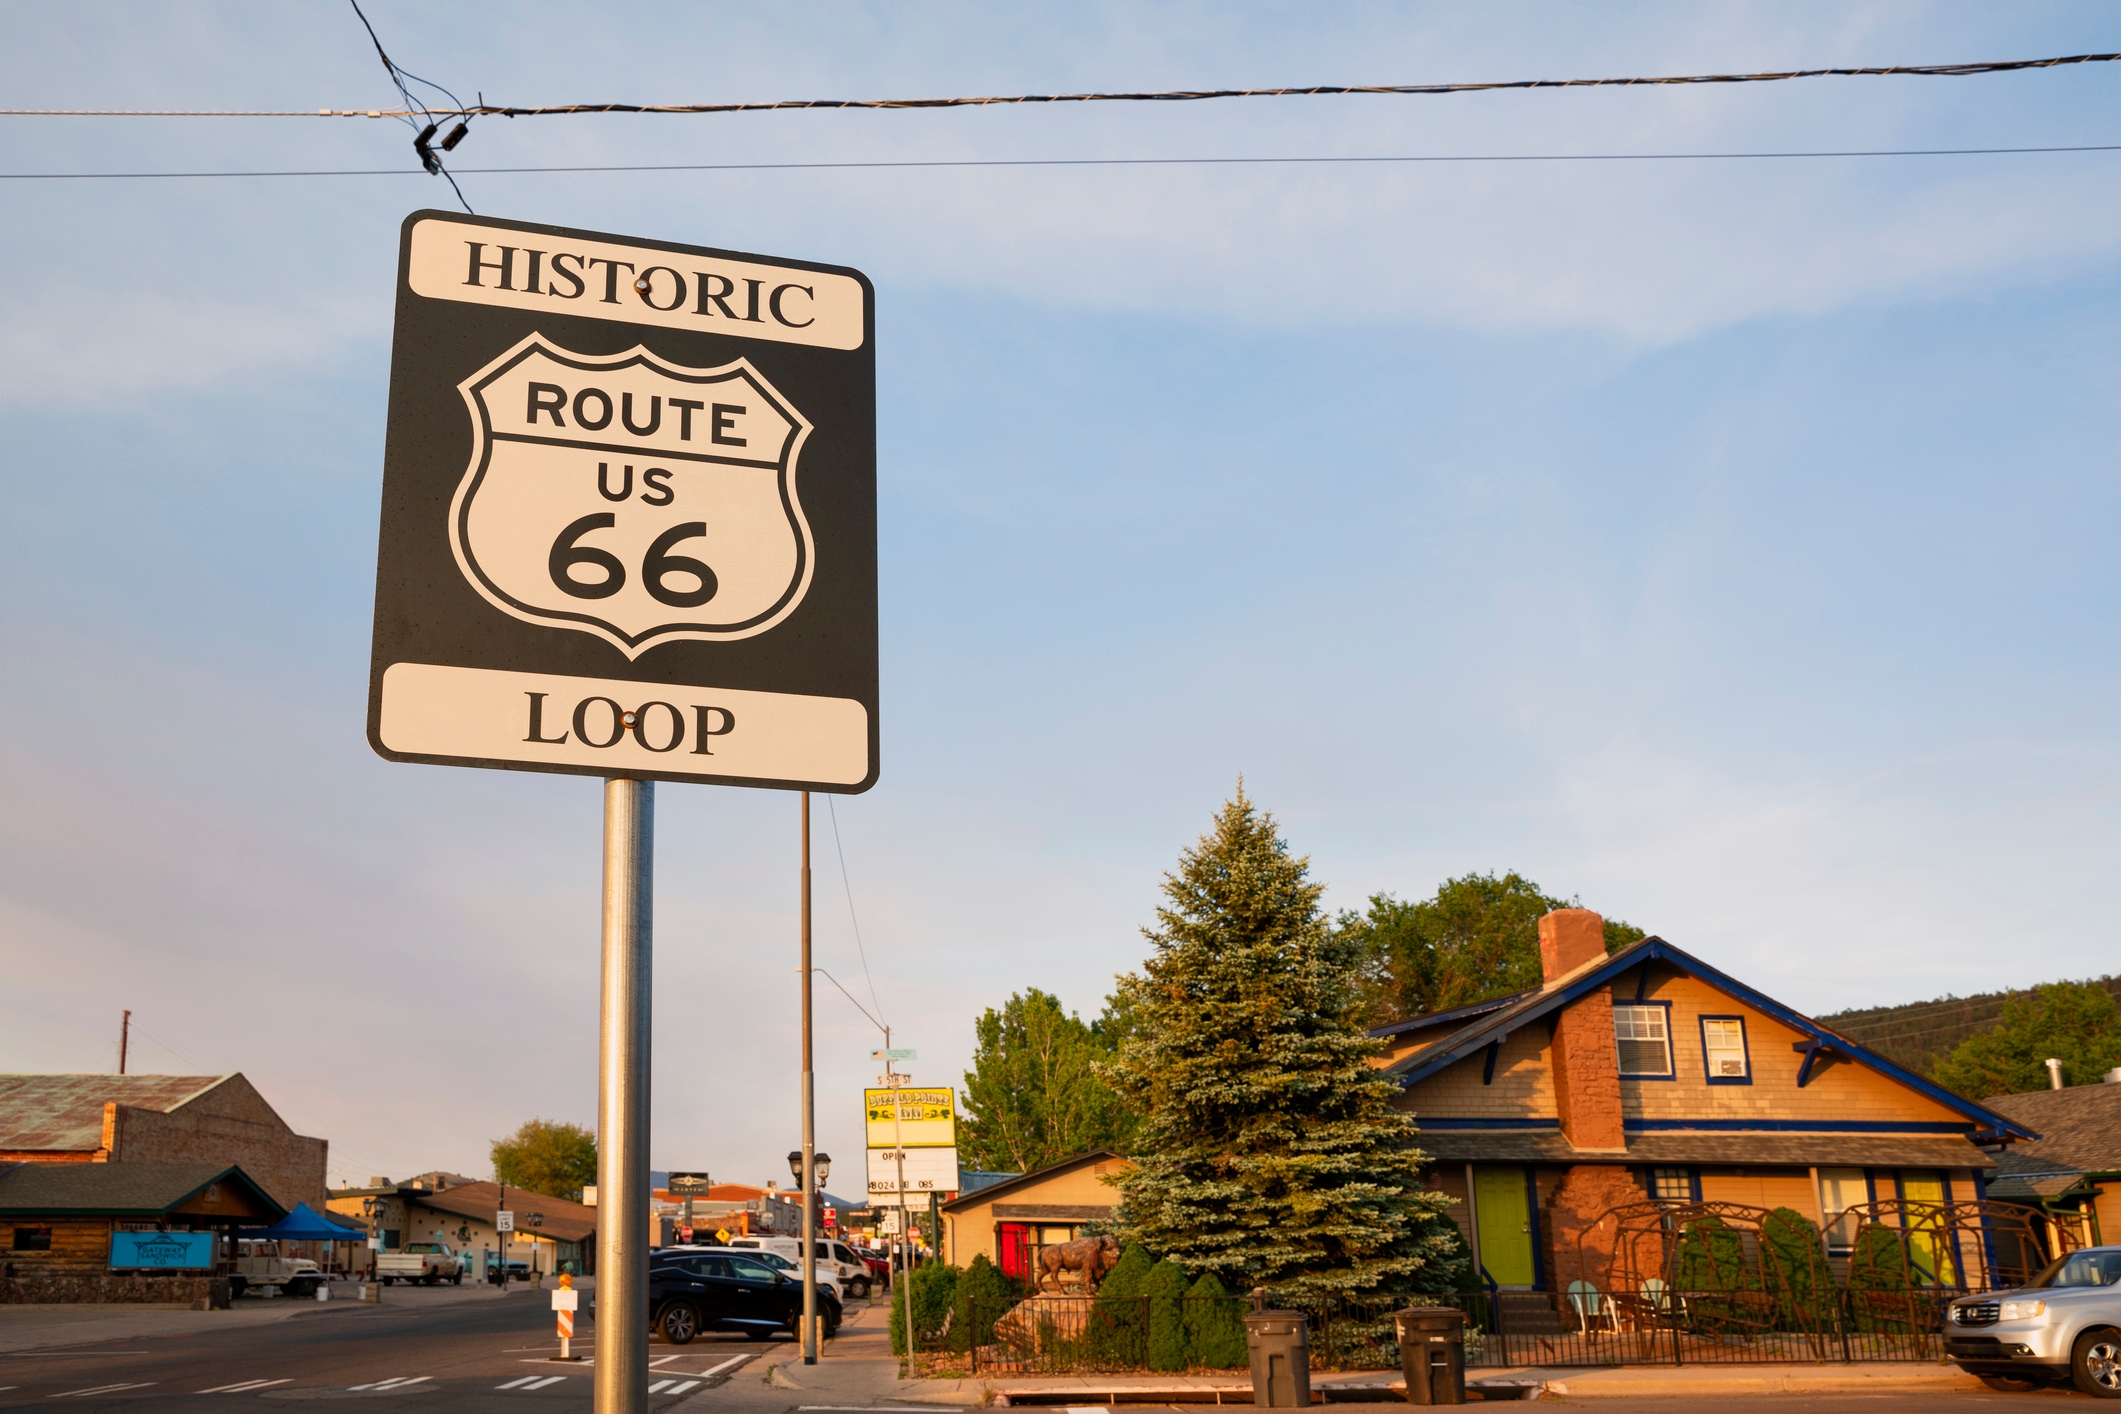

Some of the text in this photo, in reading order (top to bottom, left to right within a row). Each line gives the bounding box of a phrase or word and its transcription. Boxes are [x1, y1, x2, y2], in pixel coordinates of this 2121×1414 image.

[462, 241, 816, 329] HISTORIC
[526, 382, 748, 448] ROUTE
[597, 462, 675, 507] US
[548, 512, 719, 609] 66
[522, 692, 736, 757] LOOP
[877, 1074, 911, 1085] S 5TH ST
[869, 1092, 912, 1107] BUFFLO
[899, 1106, 924, 1120] NN
[500, 1221, 511, 1229] 15
[885, 1222, 895, 1231] 15
